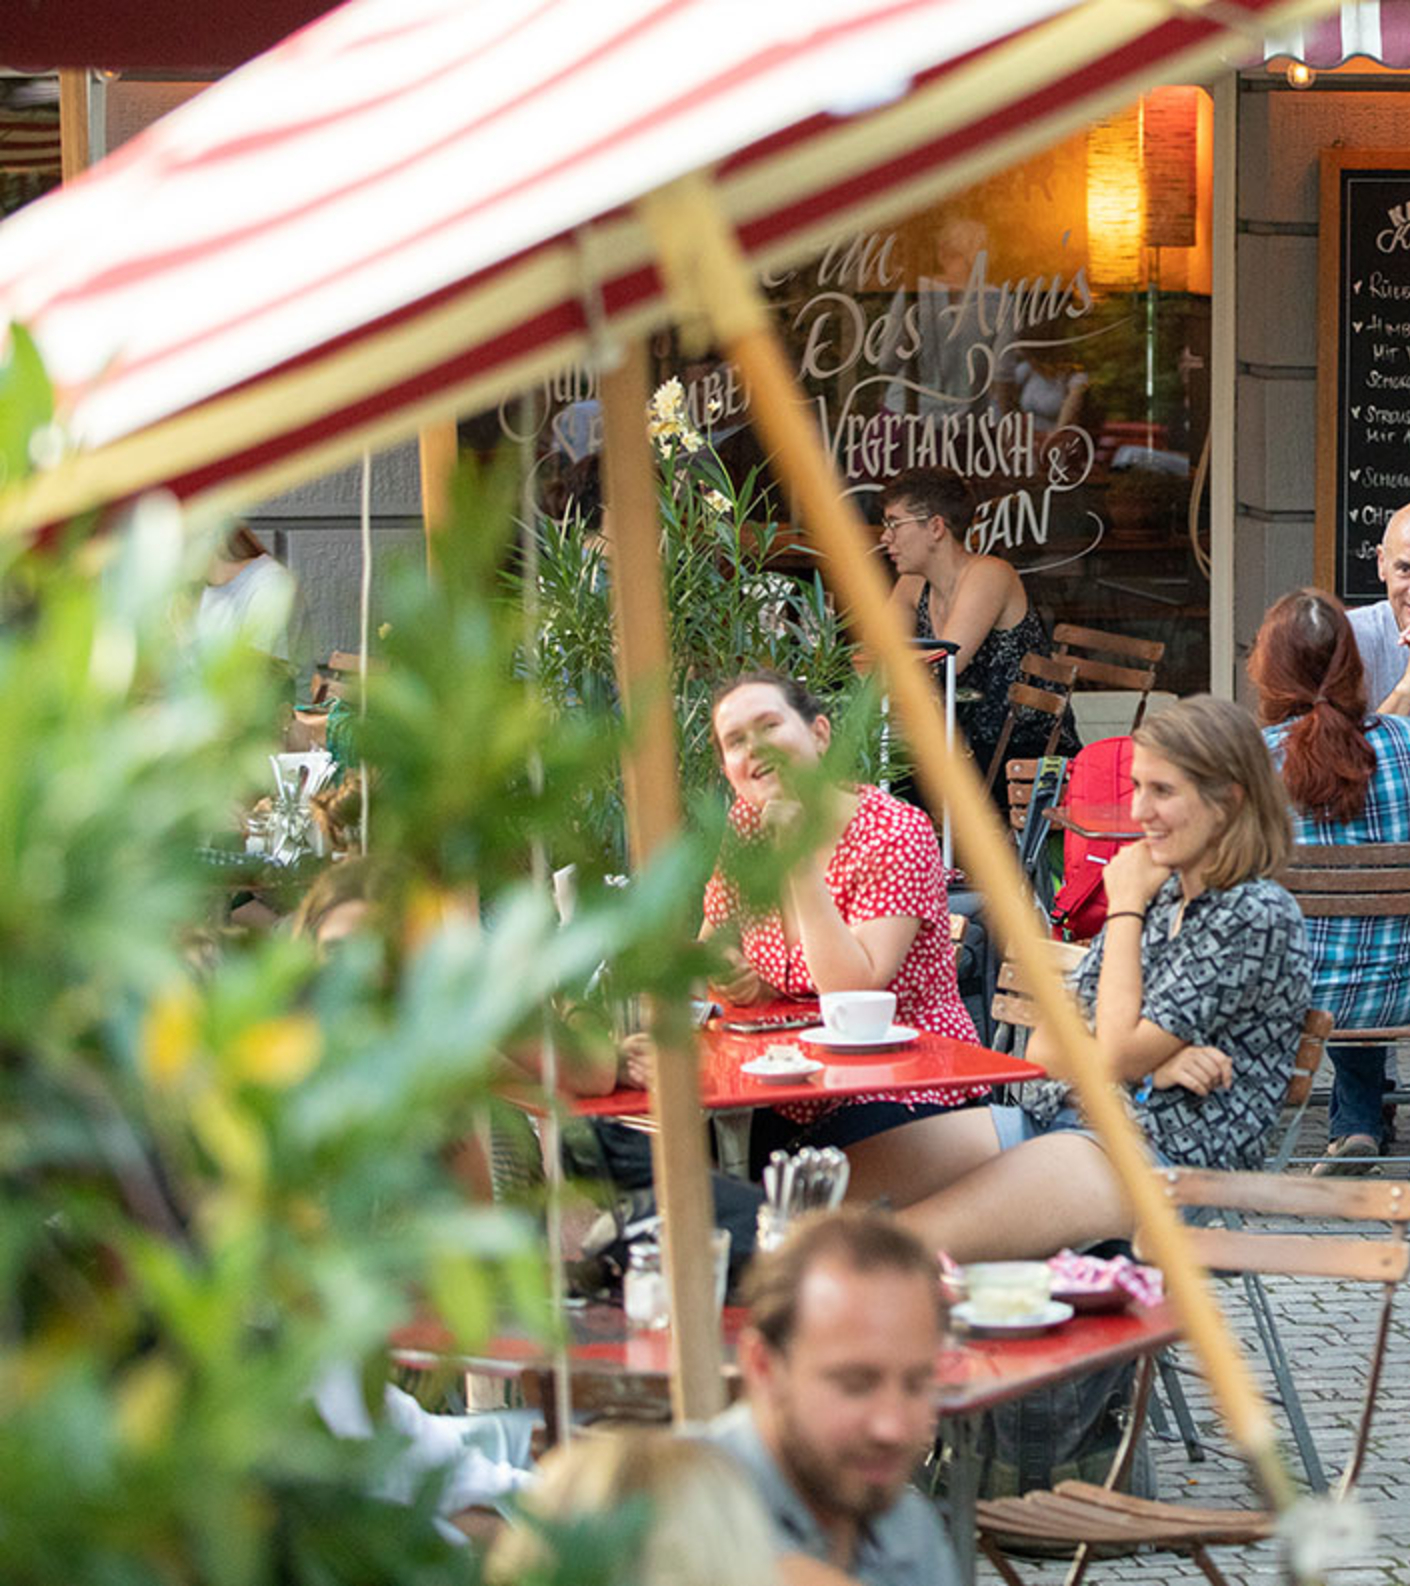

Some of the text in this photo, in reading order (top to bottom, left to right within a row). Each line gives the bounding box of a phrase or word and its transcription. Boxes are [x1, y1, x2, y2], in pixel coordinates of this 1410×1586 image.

[939, 232, 1094, 339] Amis
[816, 394, 1035, 478] VEGETARISCH
[964, 488, 1052, 556] GAN
